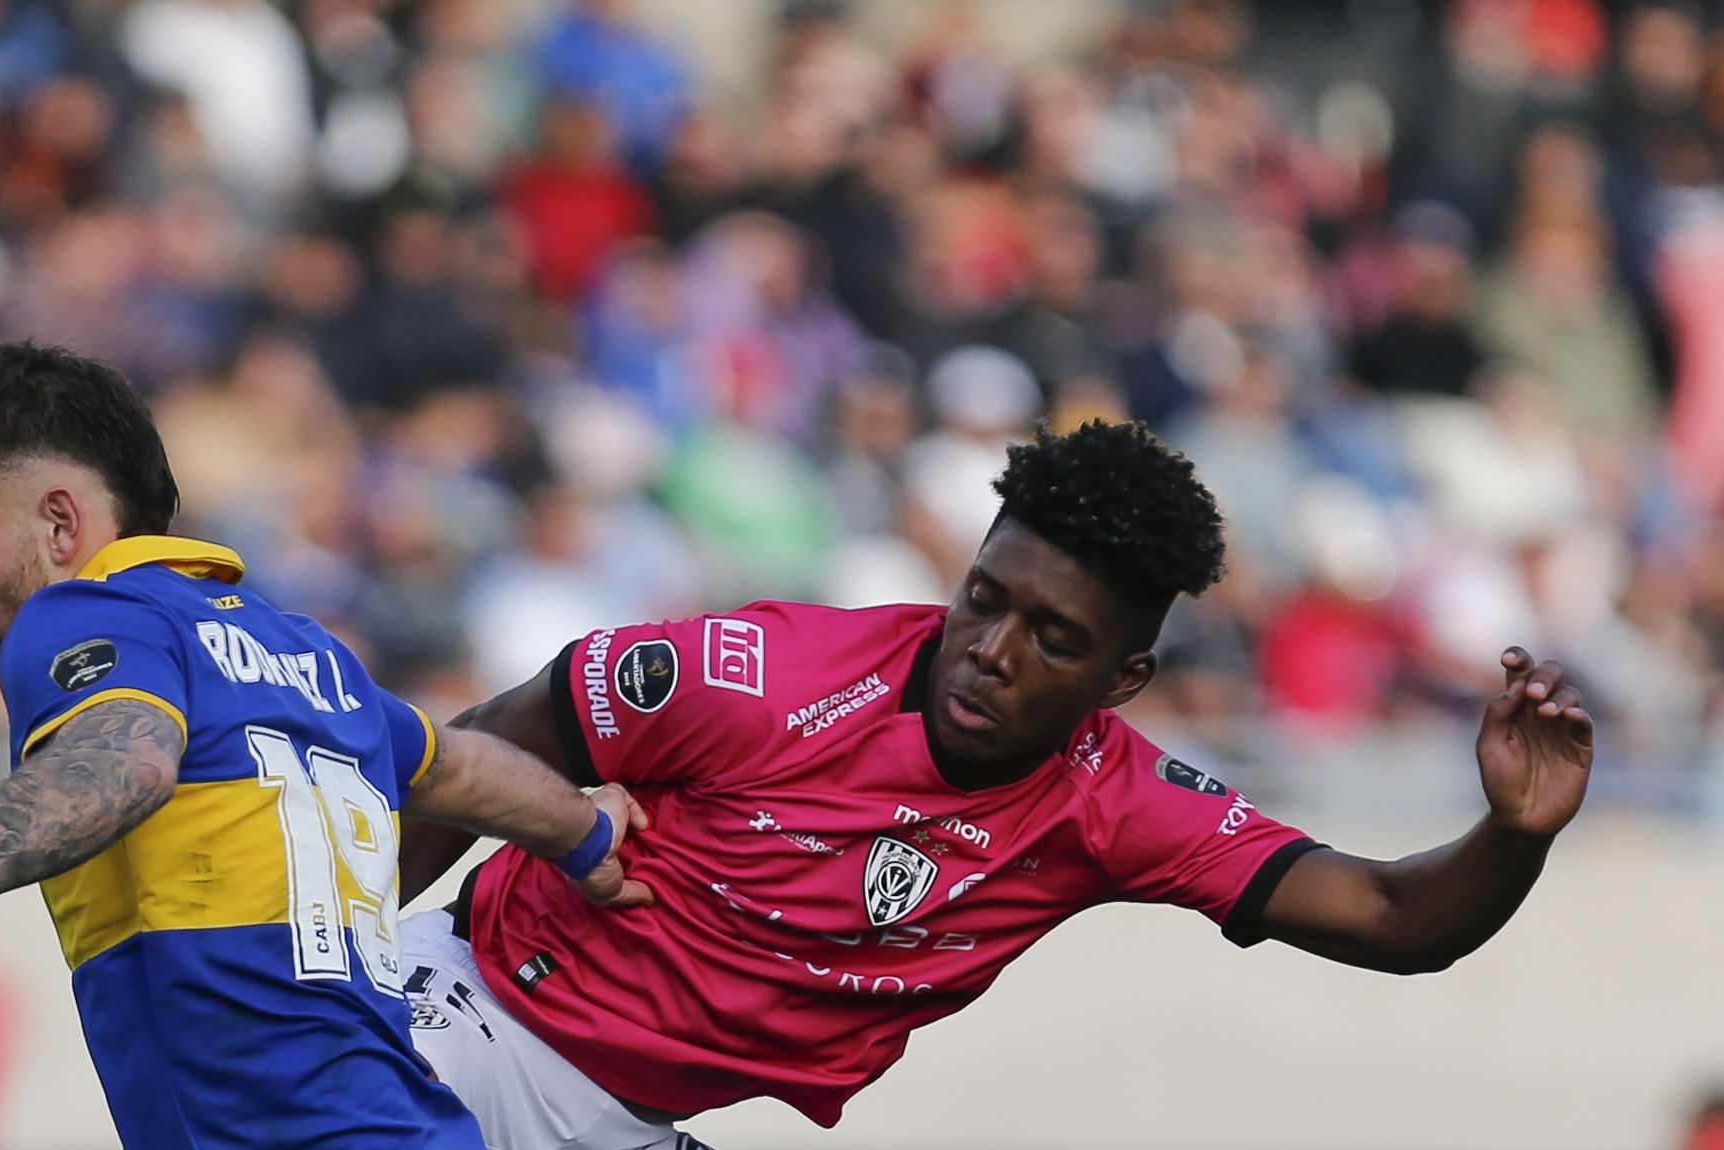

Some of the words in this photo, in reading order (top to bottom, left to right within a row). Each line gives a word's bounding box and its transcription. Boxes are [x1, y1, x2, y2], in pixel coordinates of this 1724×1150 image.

[787, 672, 882, 731] AMERICAN
[802, 683, 891, 738] EXPRESS
[244, 724, 403, 1000] 19
[312, 903, 331, 954] CABJ
